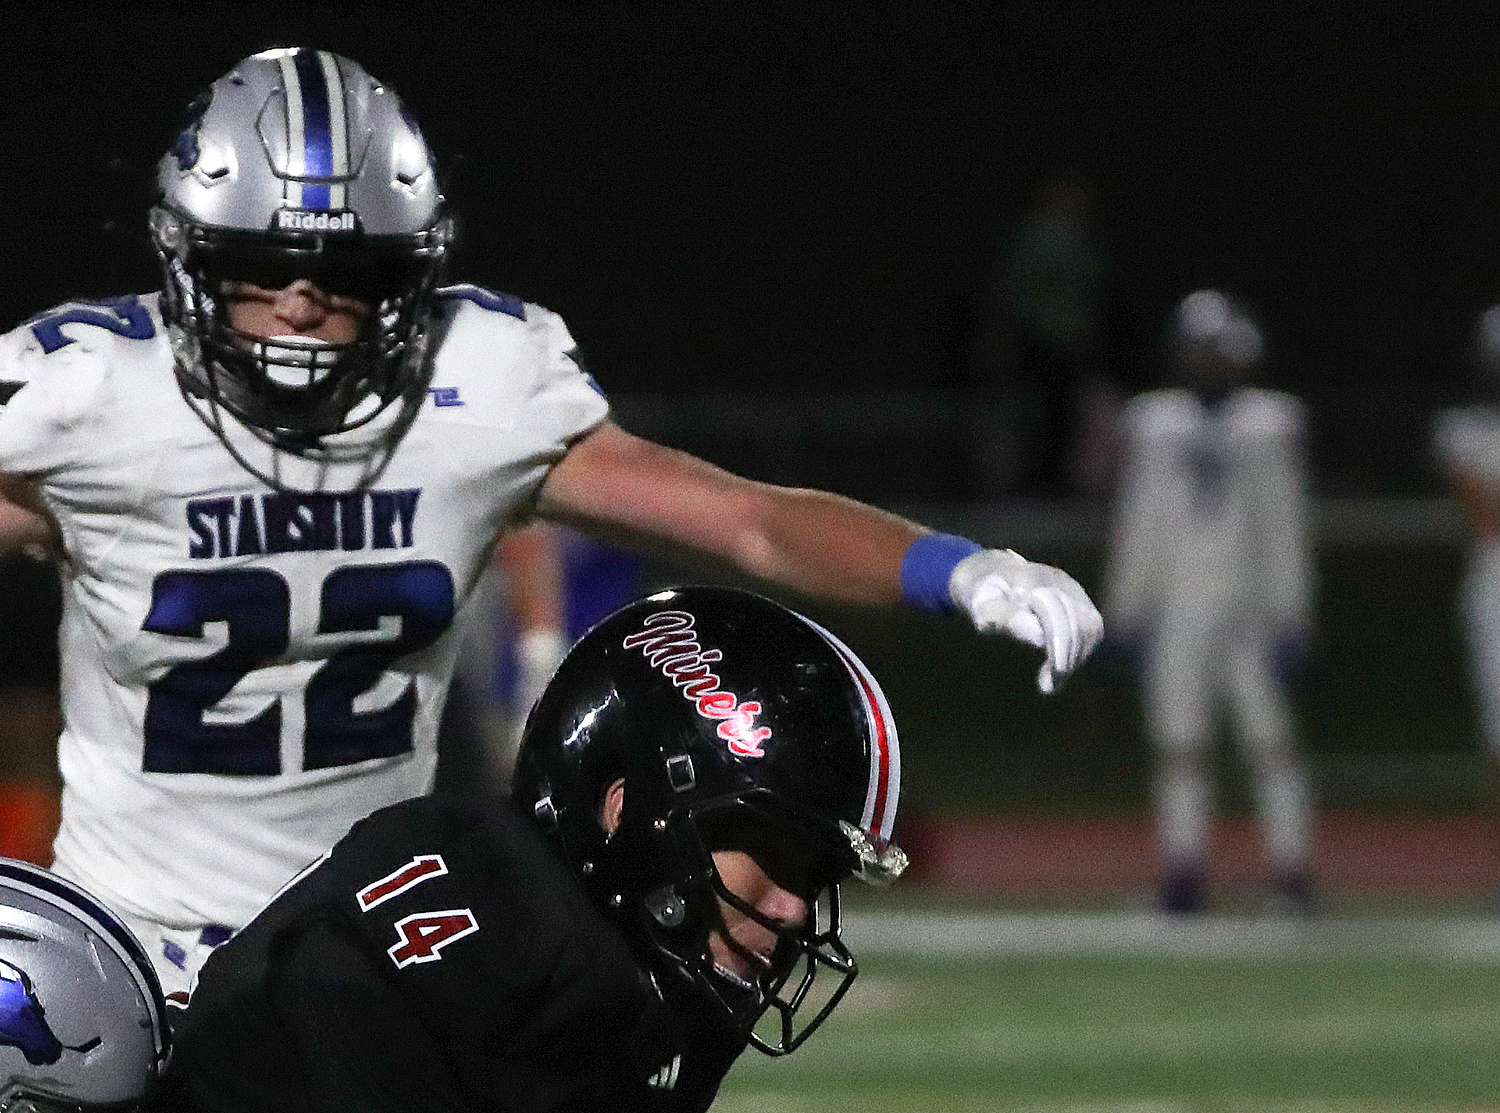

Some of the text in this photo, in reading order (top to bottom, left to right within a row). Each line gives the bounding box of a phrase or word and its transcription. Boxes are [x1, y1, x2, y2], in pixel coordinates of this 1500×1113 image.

[279, 211, 354, 230] Riddell
[140, 559, 455, 777] 22
[622, 610, 773, 758] Miners
[356, 854, 480, 970] 14
